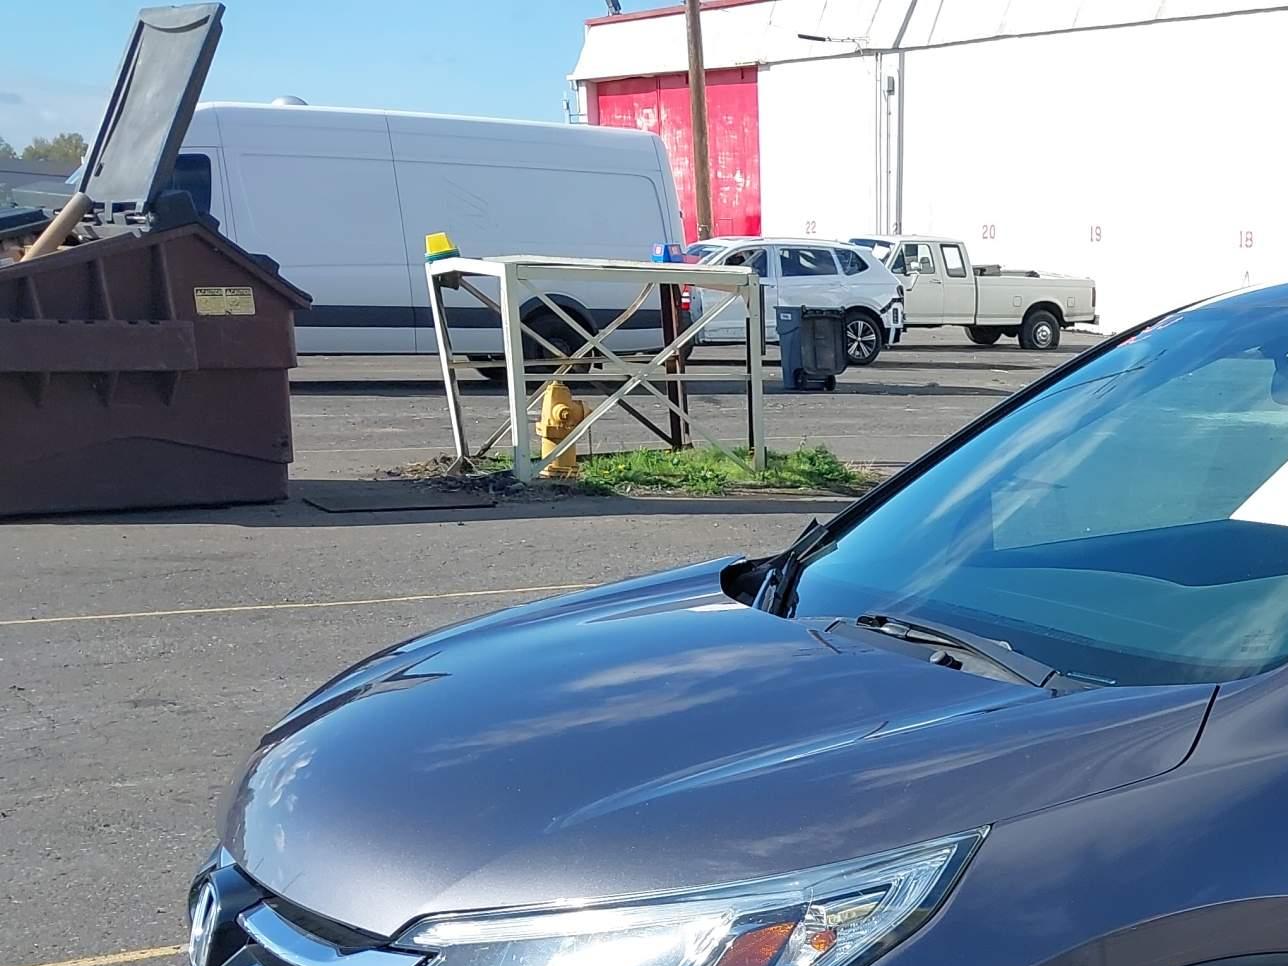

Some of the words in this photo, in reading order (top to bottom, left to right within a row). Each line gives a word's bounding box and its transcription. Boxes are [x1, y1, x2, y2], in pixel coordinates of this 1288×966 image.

[805, 220, 817, 235] 22
[981, 224, 996, 240] 20
[1089, 224, 1102, 243] 19
[1239, 230, 1254, 249] 18
